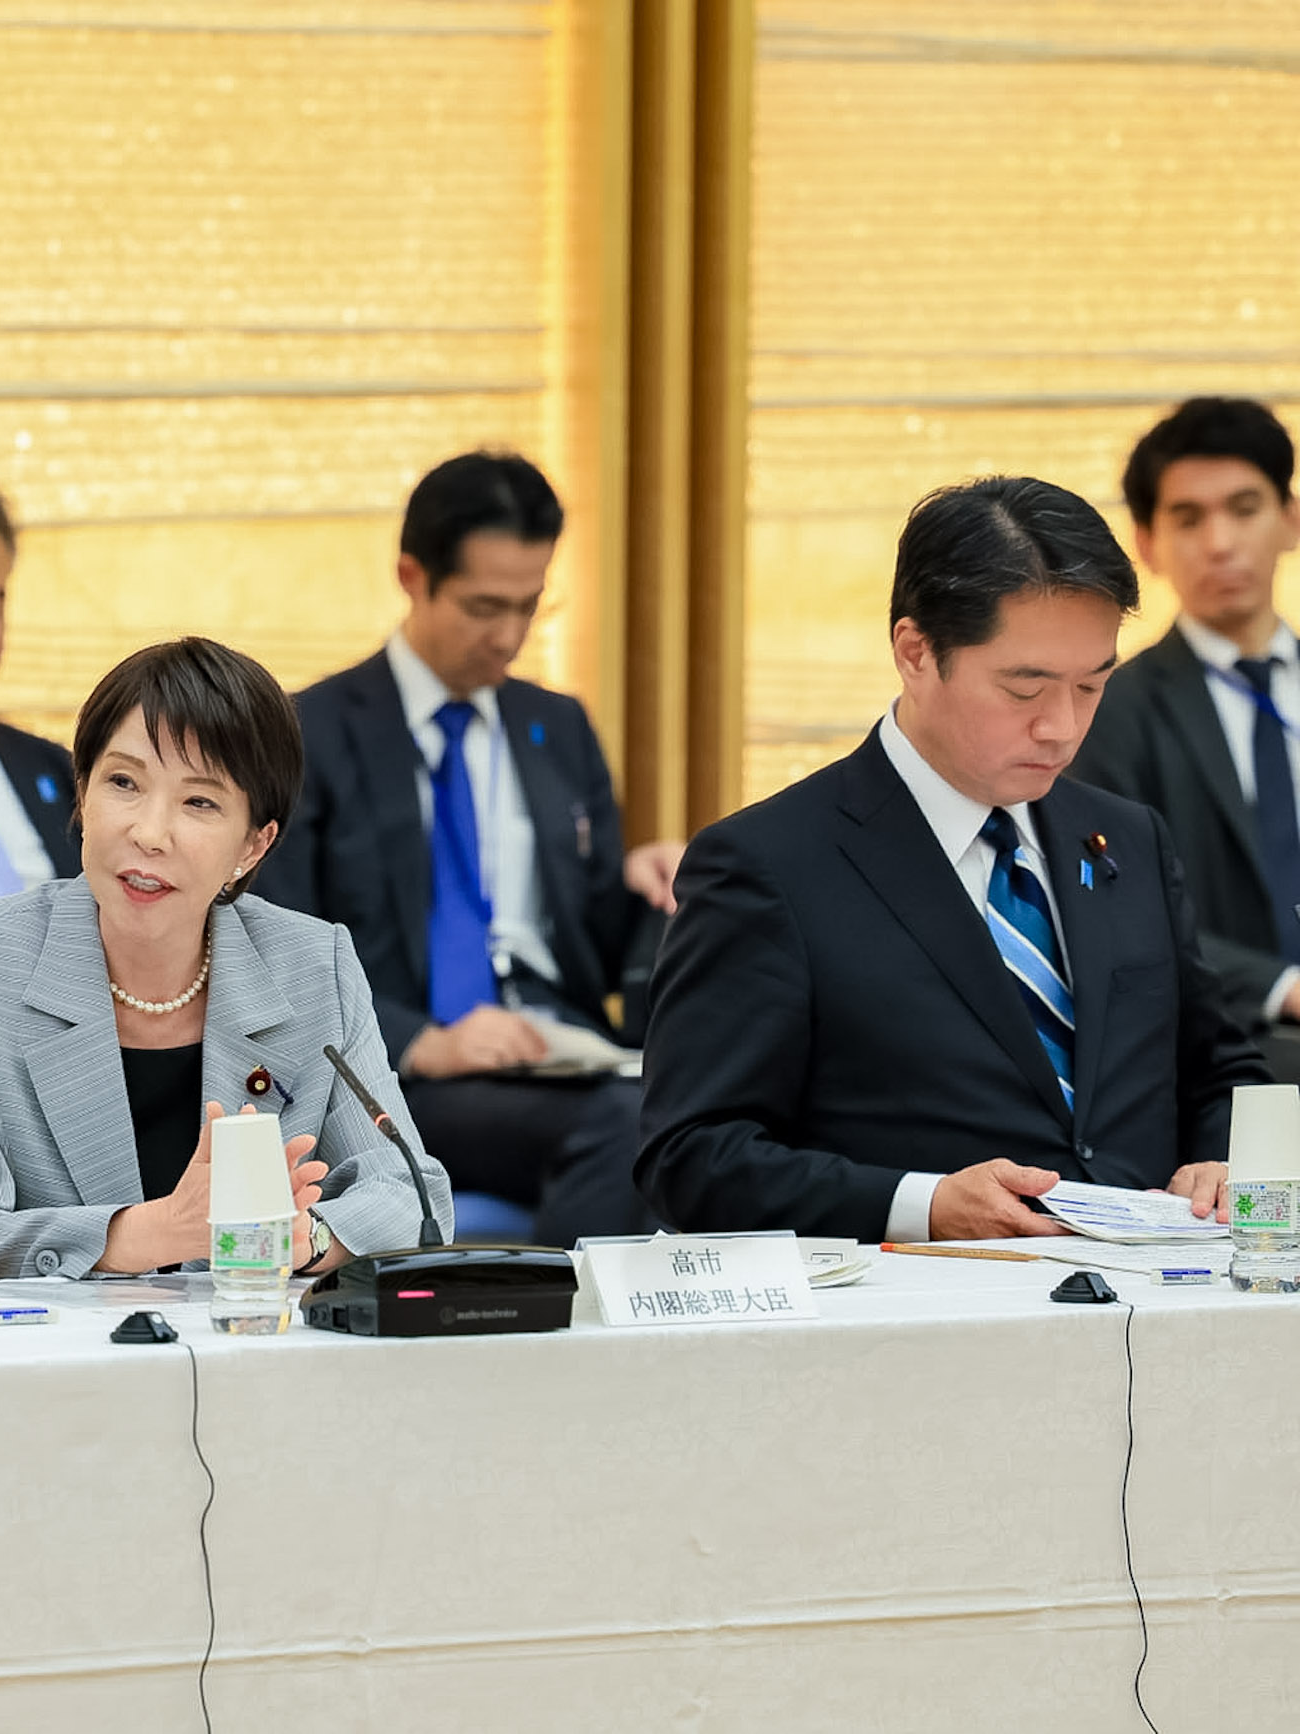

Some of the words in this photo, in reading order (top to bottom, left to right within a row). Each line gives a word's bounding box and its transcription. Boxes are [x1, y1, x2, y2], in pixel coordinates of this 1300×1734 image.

[668, 1248, 722, 1277] 高市
[629, 1286, 793, 1319] 内閣総理大臣
